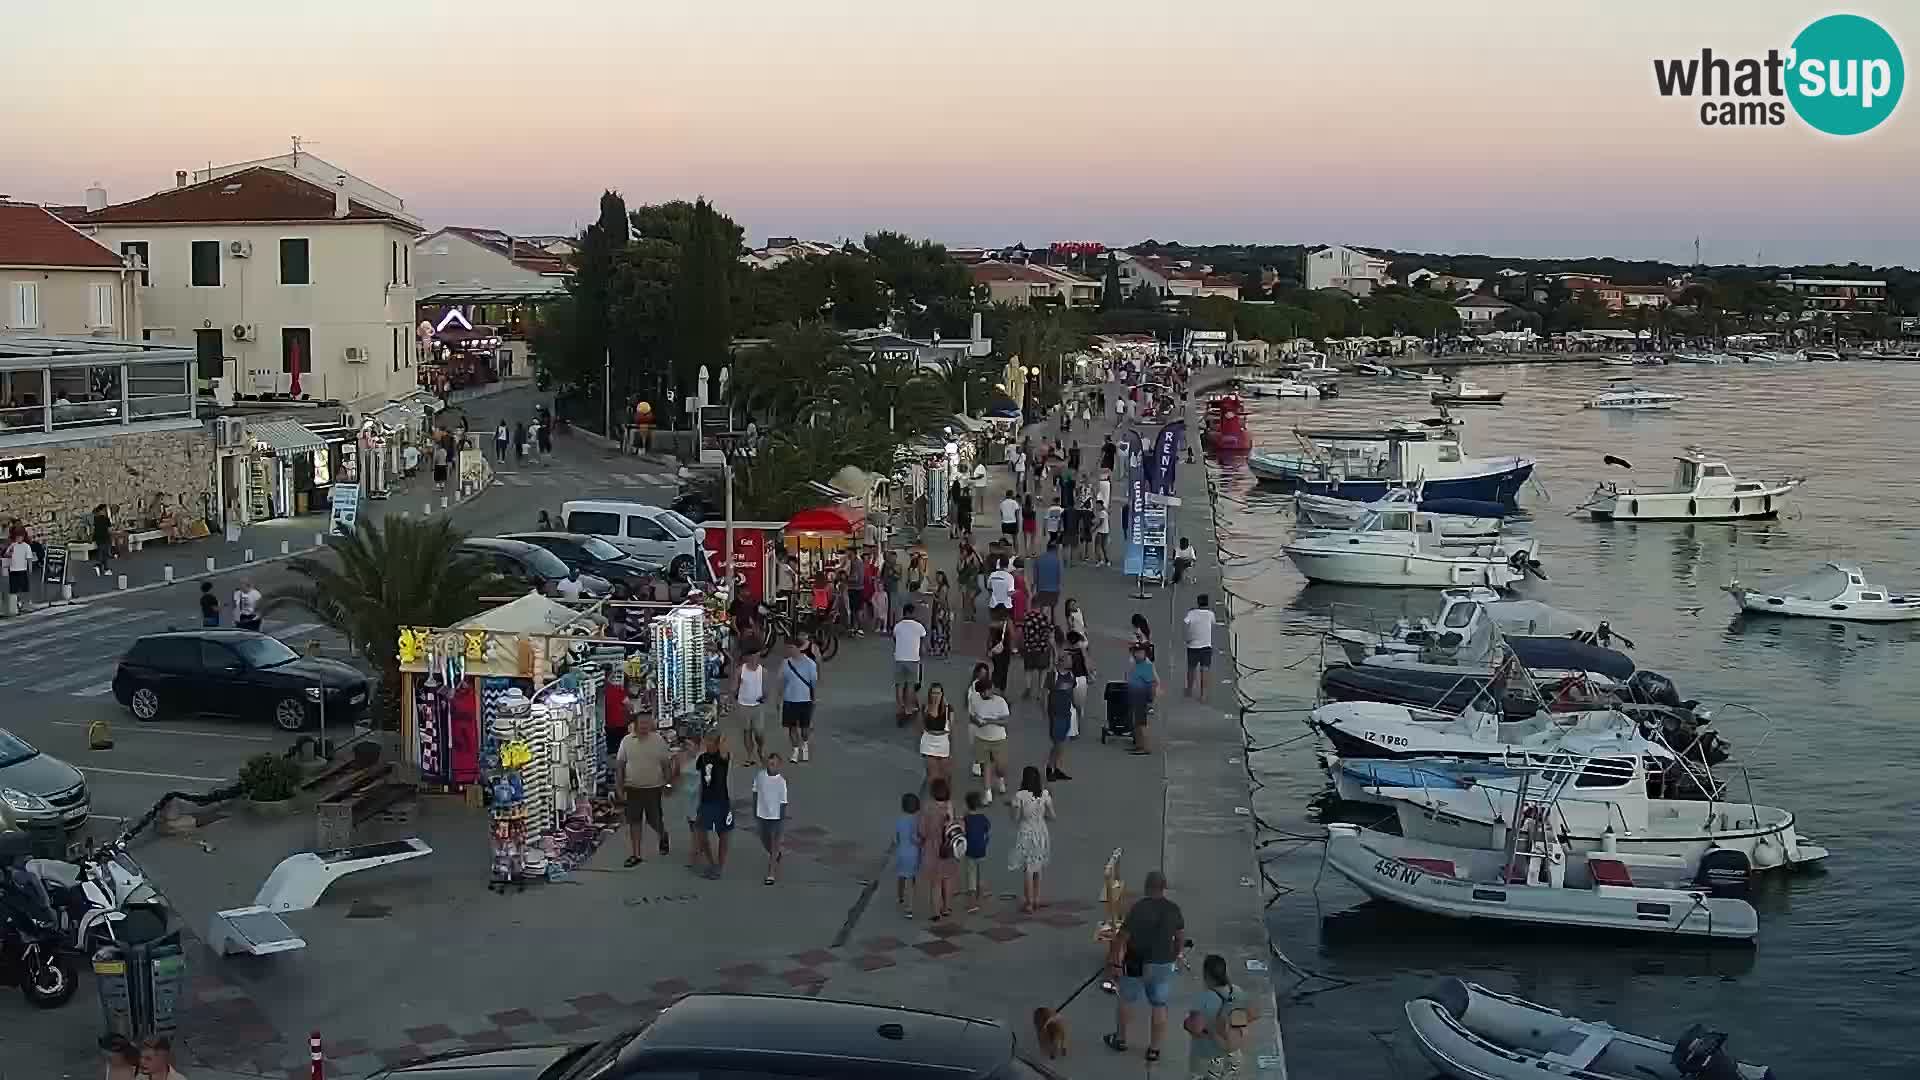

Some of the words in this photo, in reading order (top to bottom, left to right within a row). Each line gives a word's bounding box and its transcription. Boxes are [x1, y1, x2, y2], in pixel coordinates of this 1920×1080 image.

[1160, 431, 1173, 478] RENT
[1364, 731, 1376, 741] IZ
[1380, 734, 1408, 747] 1980
[1374, 860, 1403, 879] 456
[1400, 868, 1425, 885] NV
